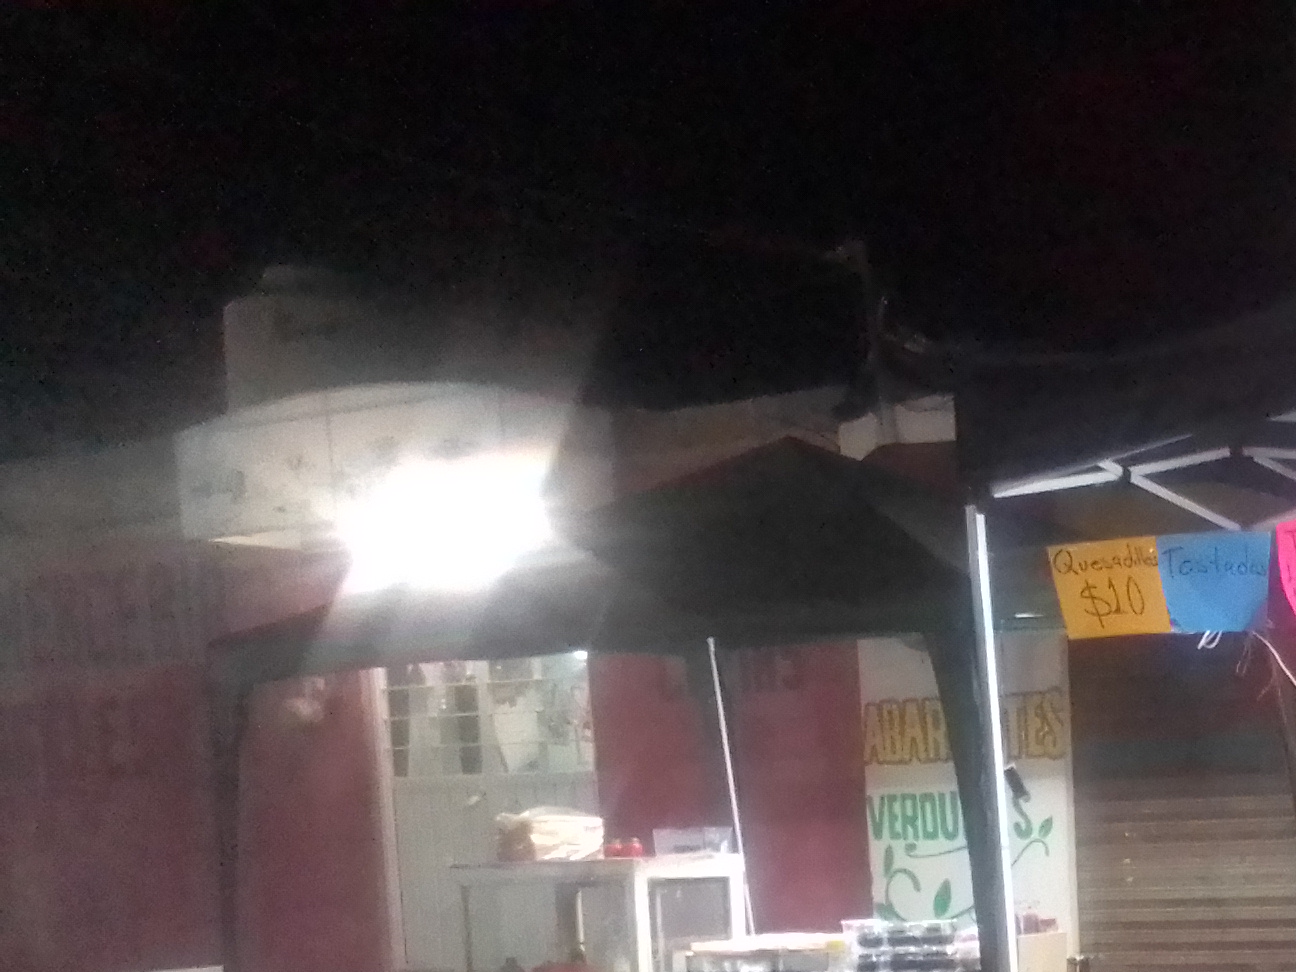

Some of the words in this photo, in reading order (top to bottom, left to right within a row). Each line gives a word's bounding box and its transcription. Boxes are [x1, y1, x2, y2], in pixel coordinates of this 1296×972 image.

[1080, 576, 1145, 628] $10
[864, 687, 1067, 766] ABARTES
[867, 790, 1034, 841] VERDUS
